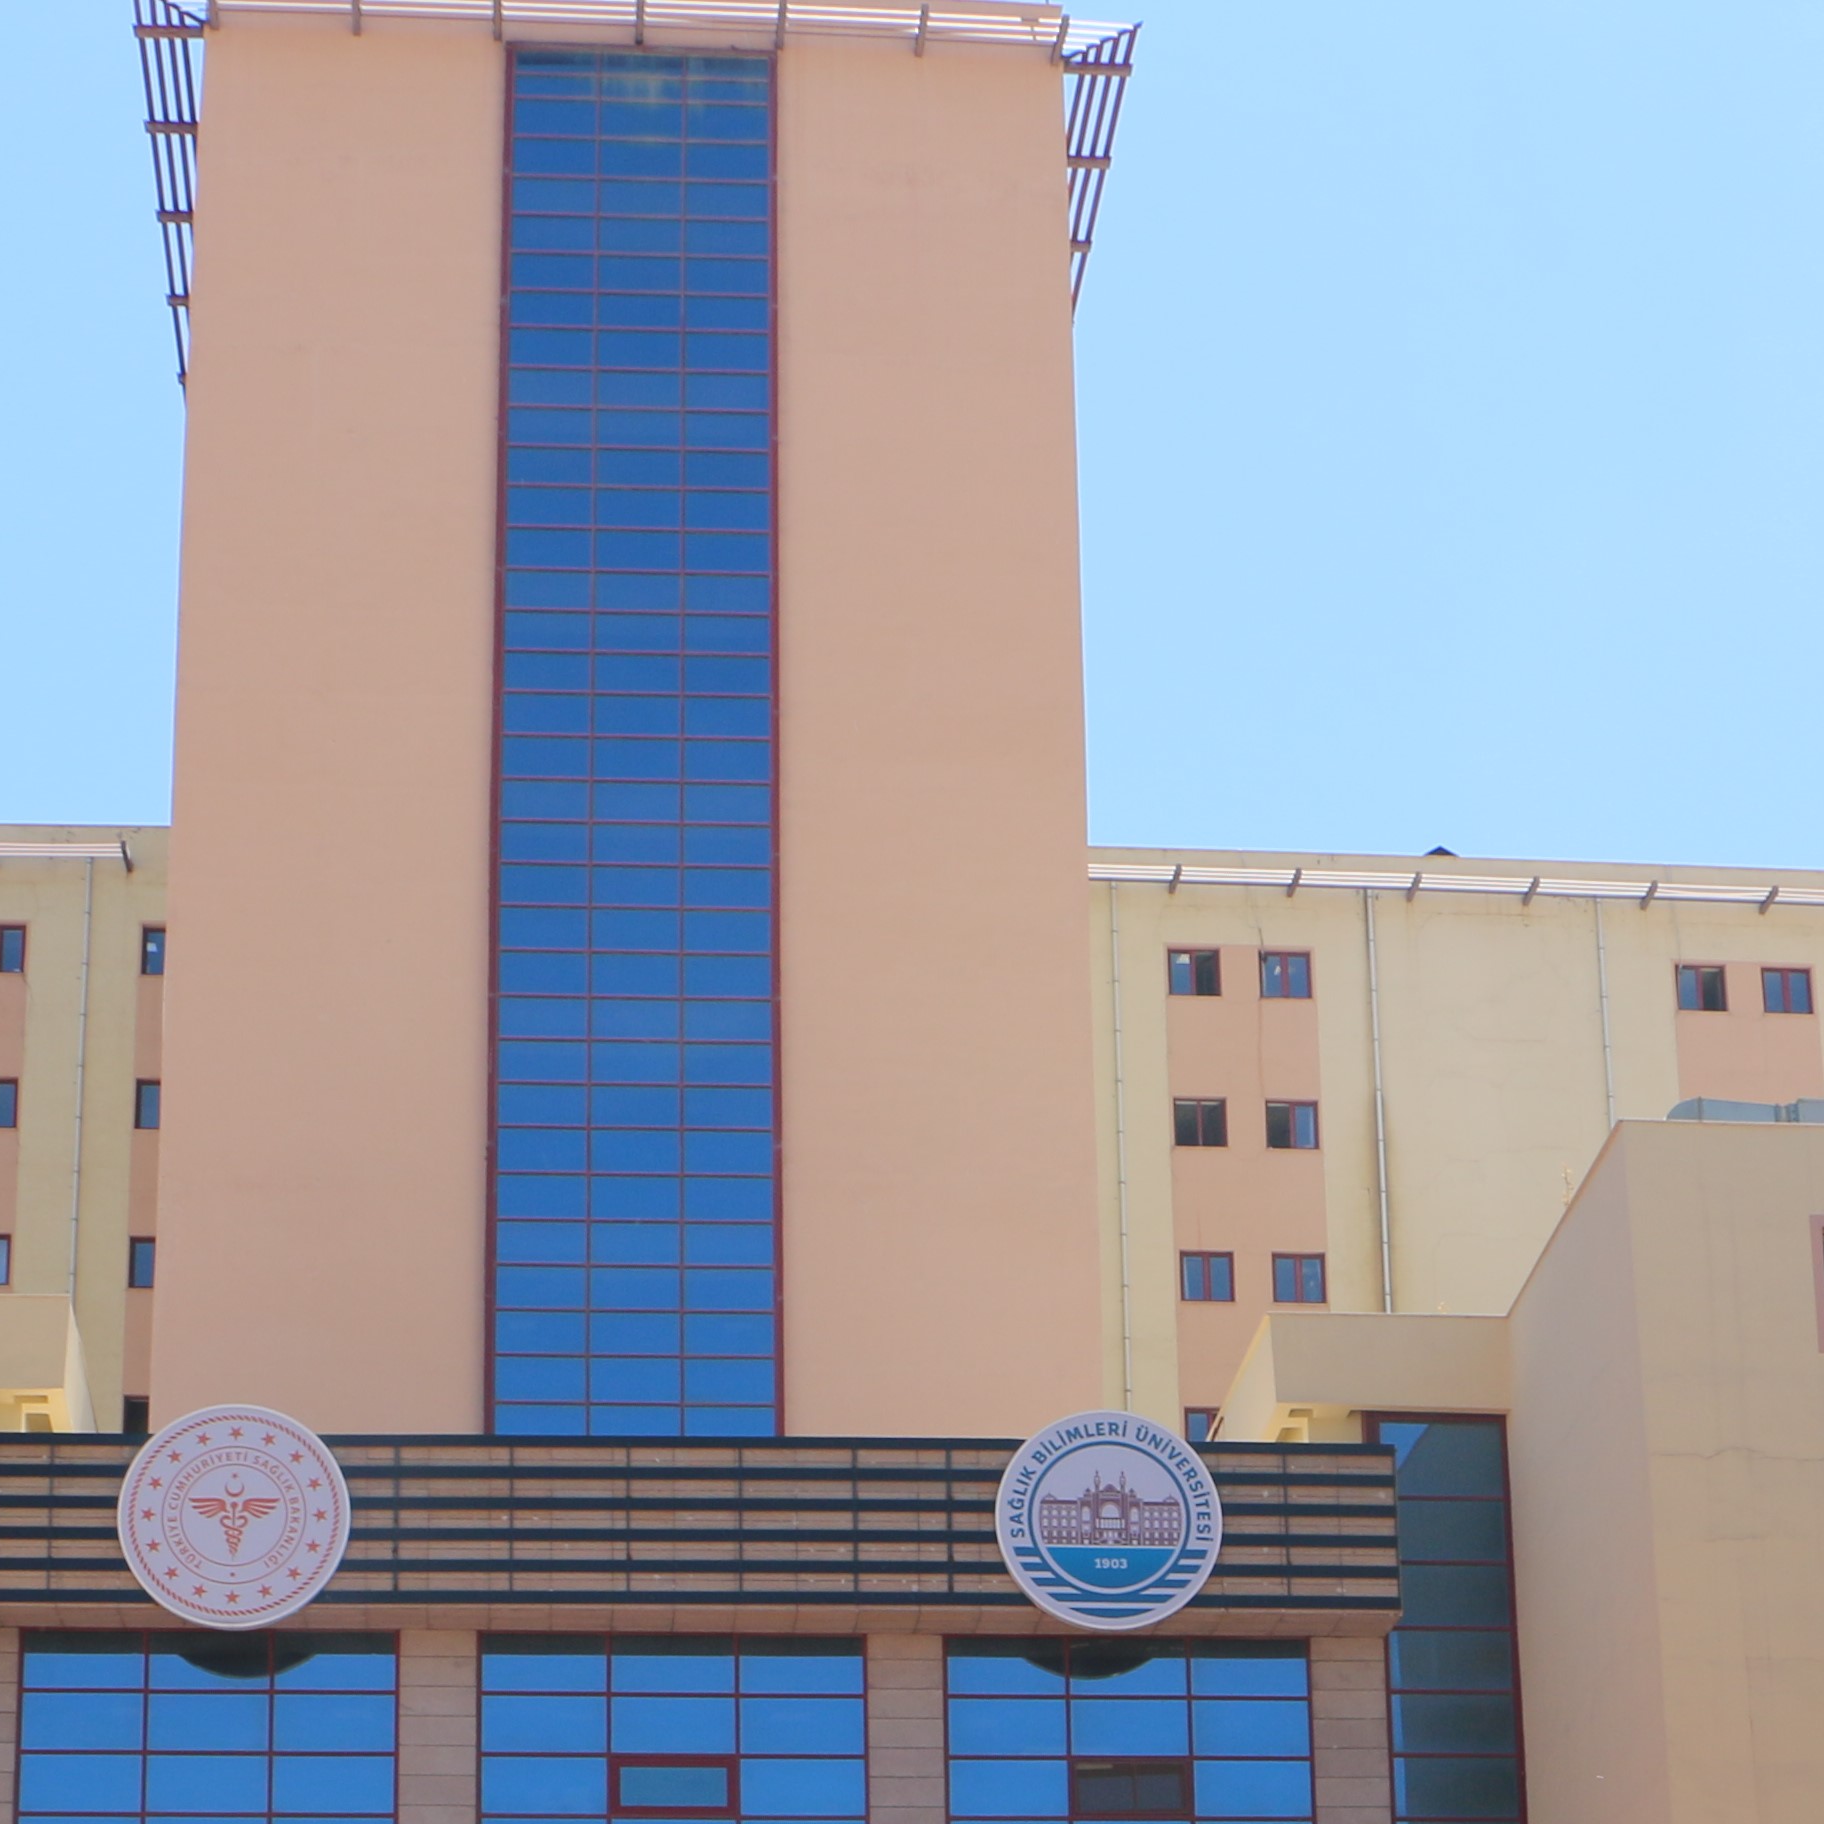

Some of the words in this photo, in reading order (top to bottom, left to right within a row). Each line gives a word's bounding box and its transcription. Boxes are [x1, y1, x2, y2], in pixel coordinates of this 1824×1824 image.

[252, 1455, 295, 1493] SAĞLIK
[1007, 1466, 1037, 1539] SAĞLIK
[1031, 1420, 1128, 1466] BİLİMLERİ
[1134, 1423, 1214, 1543] ÜNİVERSİTESİ
[1094, 1557, 1128, 1569] 1903
